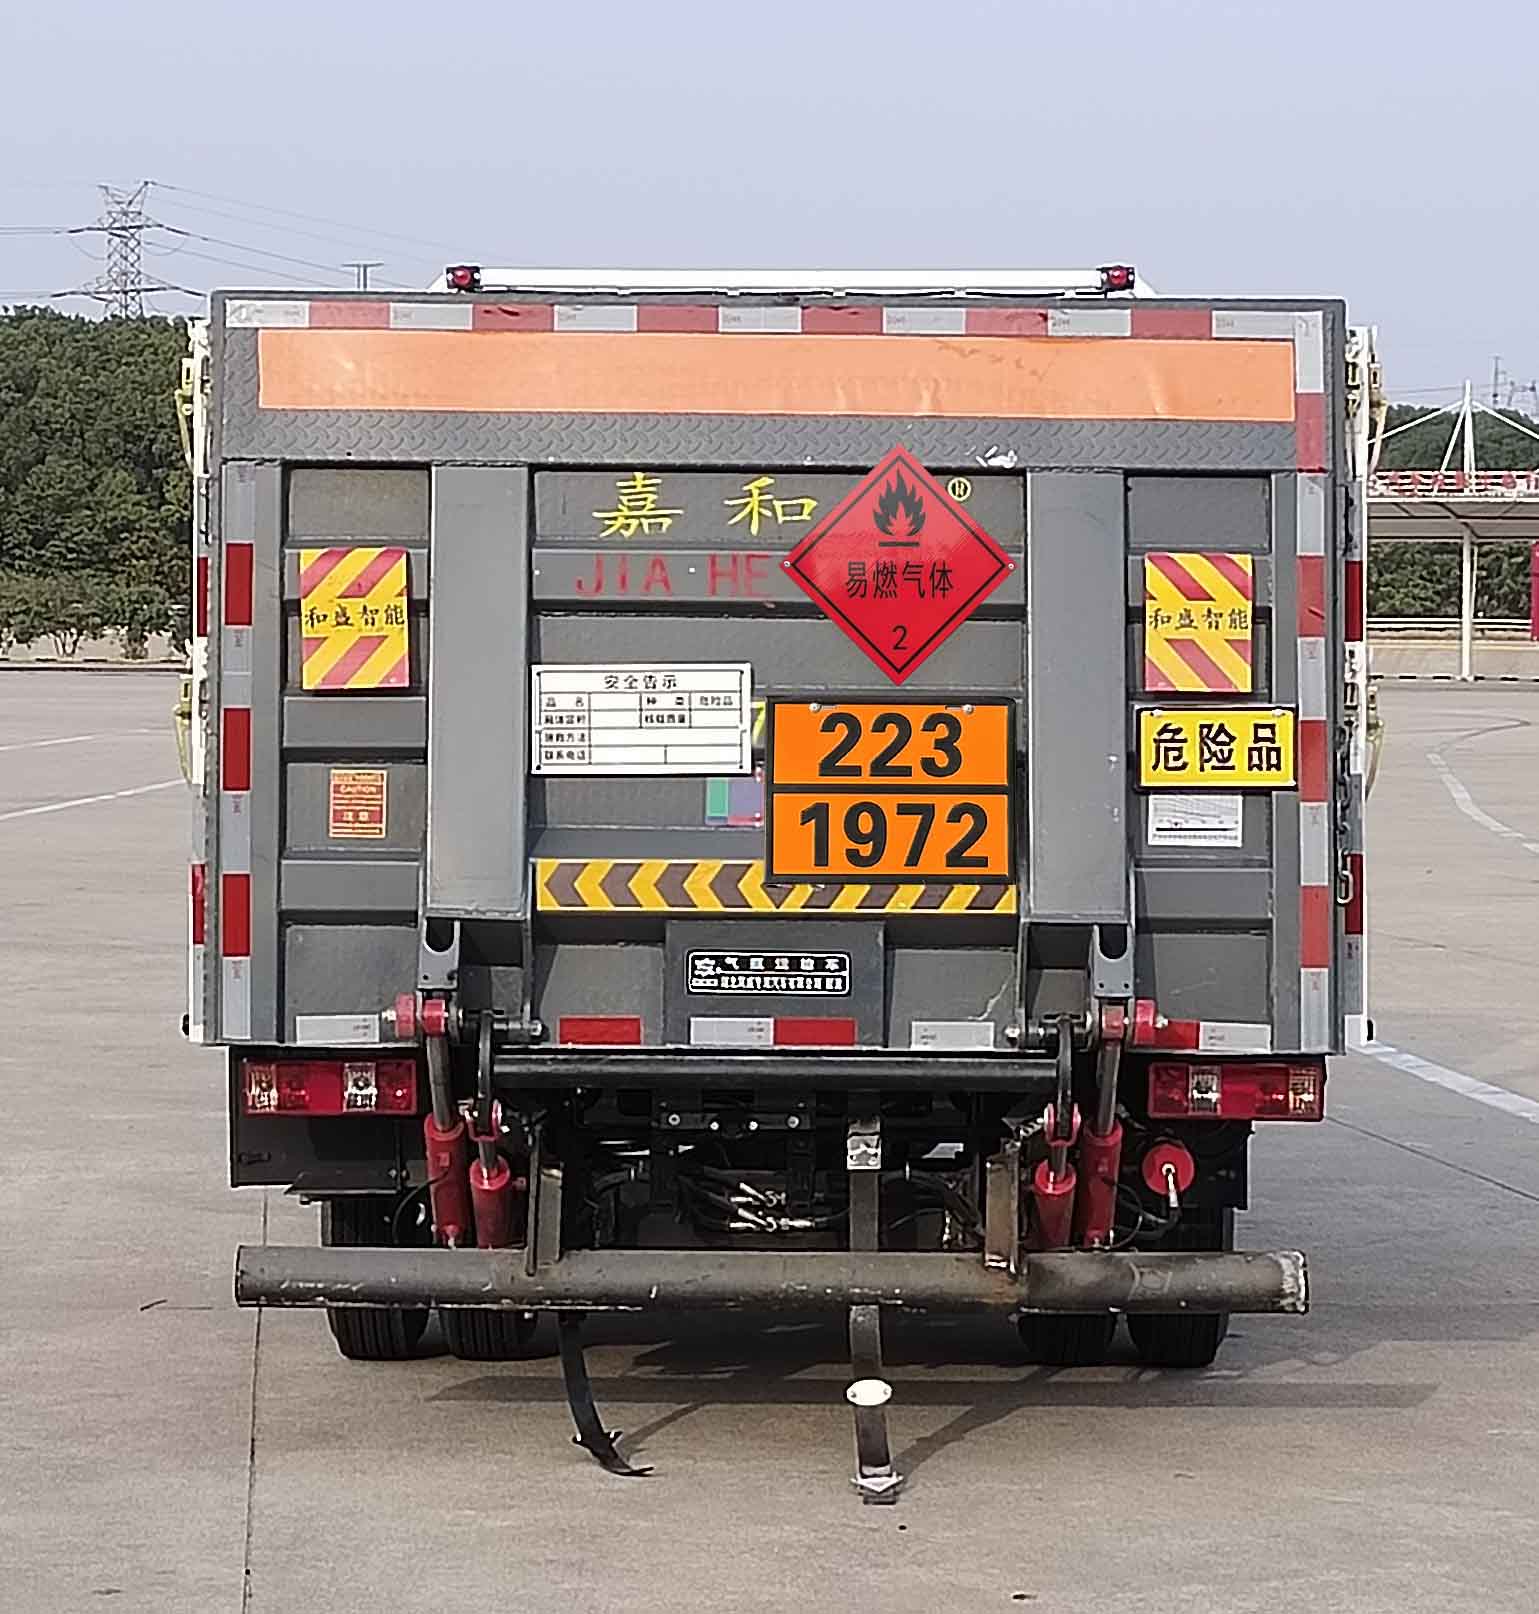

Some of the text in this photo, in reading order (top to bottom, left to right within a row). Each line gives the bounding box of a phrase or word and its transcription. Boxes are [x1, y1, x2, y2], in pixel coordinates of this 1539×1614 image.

[575, 553, 771, 597] JIA HE
[846, 560, 954, 599] 易燃气体
[304, 603, 405, 628] 和盛智能
[1149, 607, 1249, 631] 和盛智能
[892, 626, 908, 651] 2
[604, 674, 677, 689] 安全告示
[818, 712, 962, 777] 223
[1151, 722, 1282, 773] 危险品
[800, 801, 988, 868] 1972
